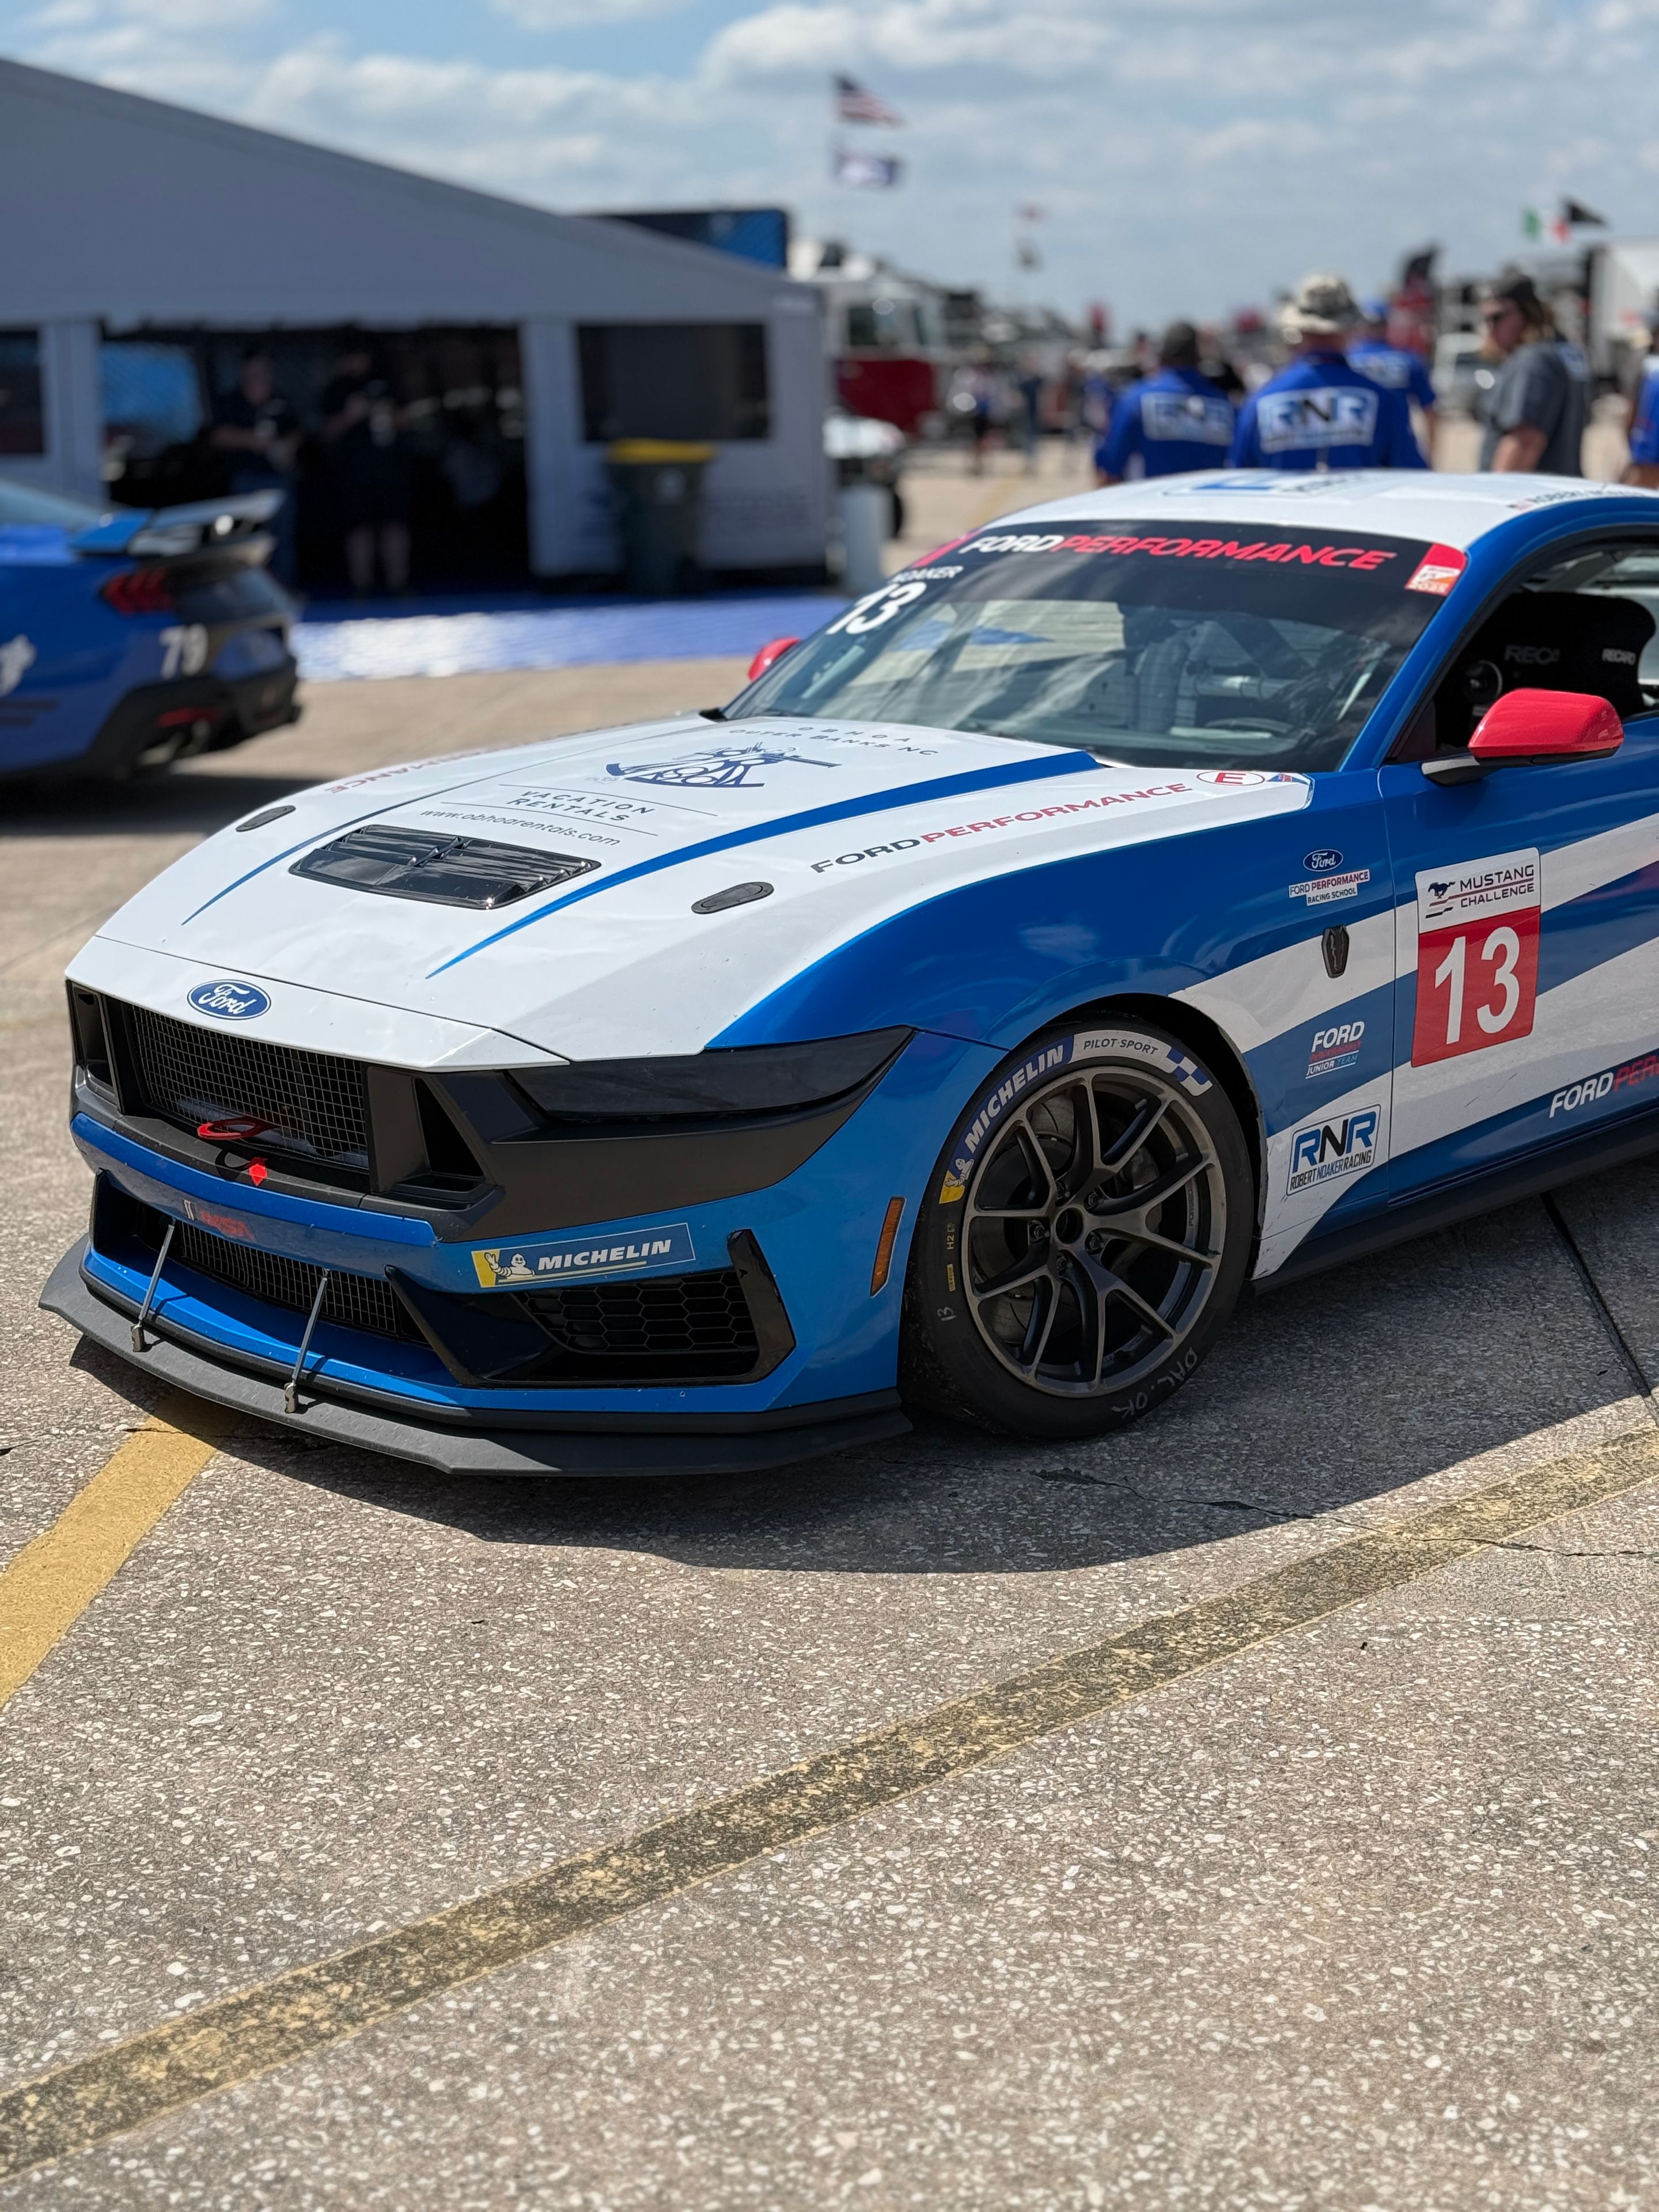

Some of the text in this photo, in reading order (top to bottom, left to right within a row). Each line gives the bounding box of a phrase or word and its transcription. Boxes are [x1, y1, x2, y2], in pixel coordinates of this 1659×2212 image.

[826, 582, 927, 634] 13
[729, 729, 940, 756] OUTER BANKS NC
[506, 798, 630, 821] RENTALS
[521, 791, 656, 815] VACATION
[420, 809, 621, 846] www.obhoarentals.com
[1311, 852, 1336, 869] Ford
[1290, 870, 1369, 896] FORD PERFORMANCE
[1460, 864, 1535, 892] MUSTANG
[1307, 887, 1357, 904] RACING SCHOOL
[1460, 882, 1535, 908] CHALLENGE
[198, 983, 257, 1014] Ford
[1435, 926, 1520, 1045] 13
[1084, 1038, 1158, 1056] PILOT SPORT
[1311, 1021, 1365, 1053] FORD
[1306, 1054, 1358, 1076] JUNIOR TEAM
[964, 1044, 1064, 1153] MICHELIN
[1292, 1111, 1377, 1174] RNR
[537, 1238, 672, 1271] MICHELIN
